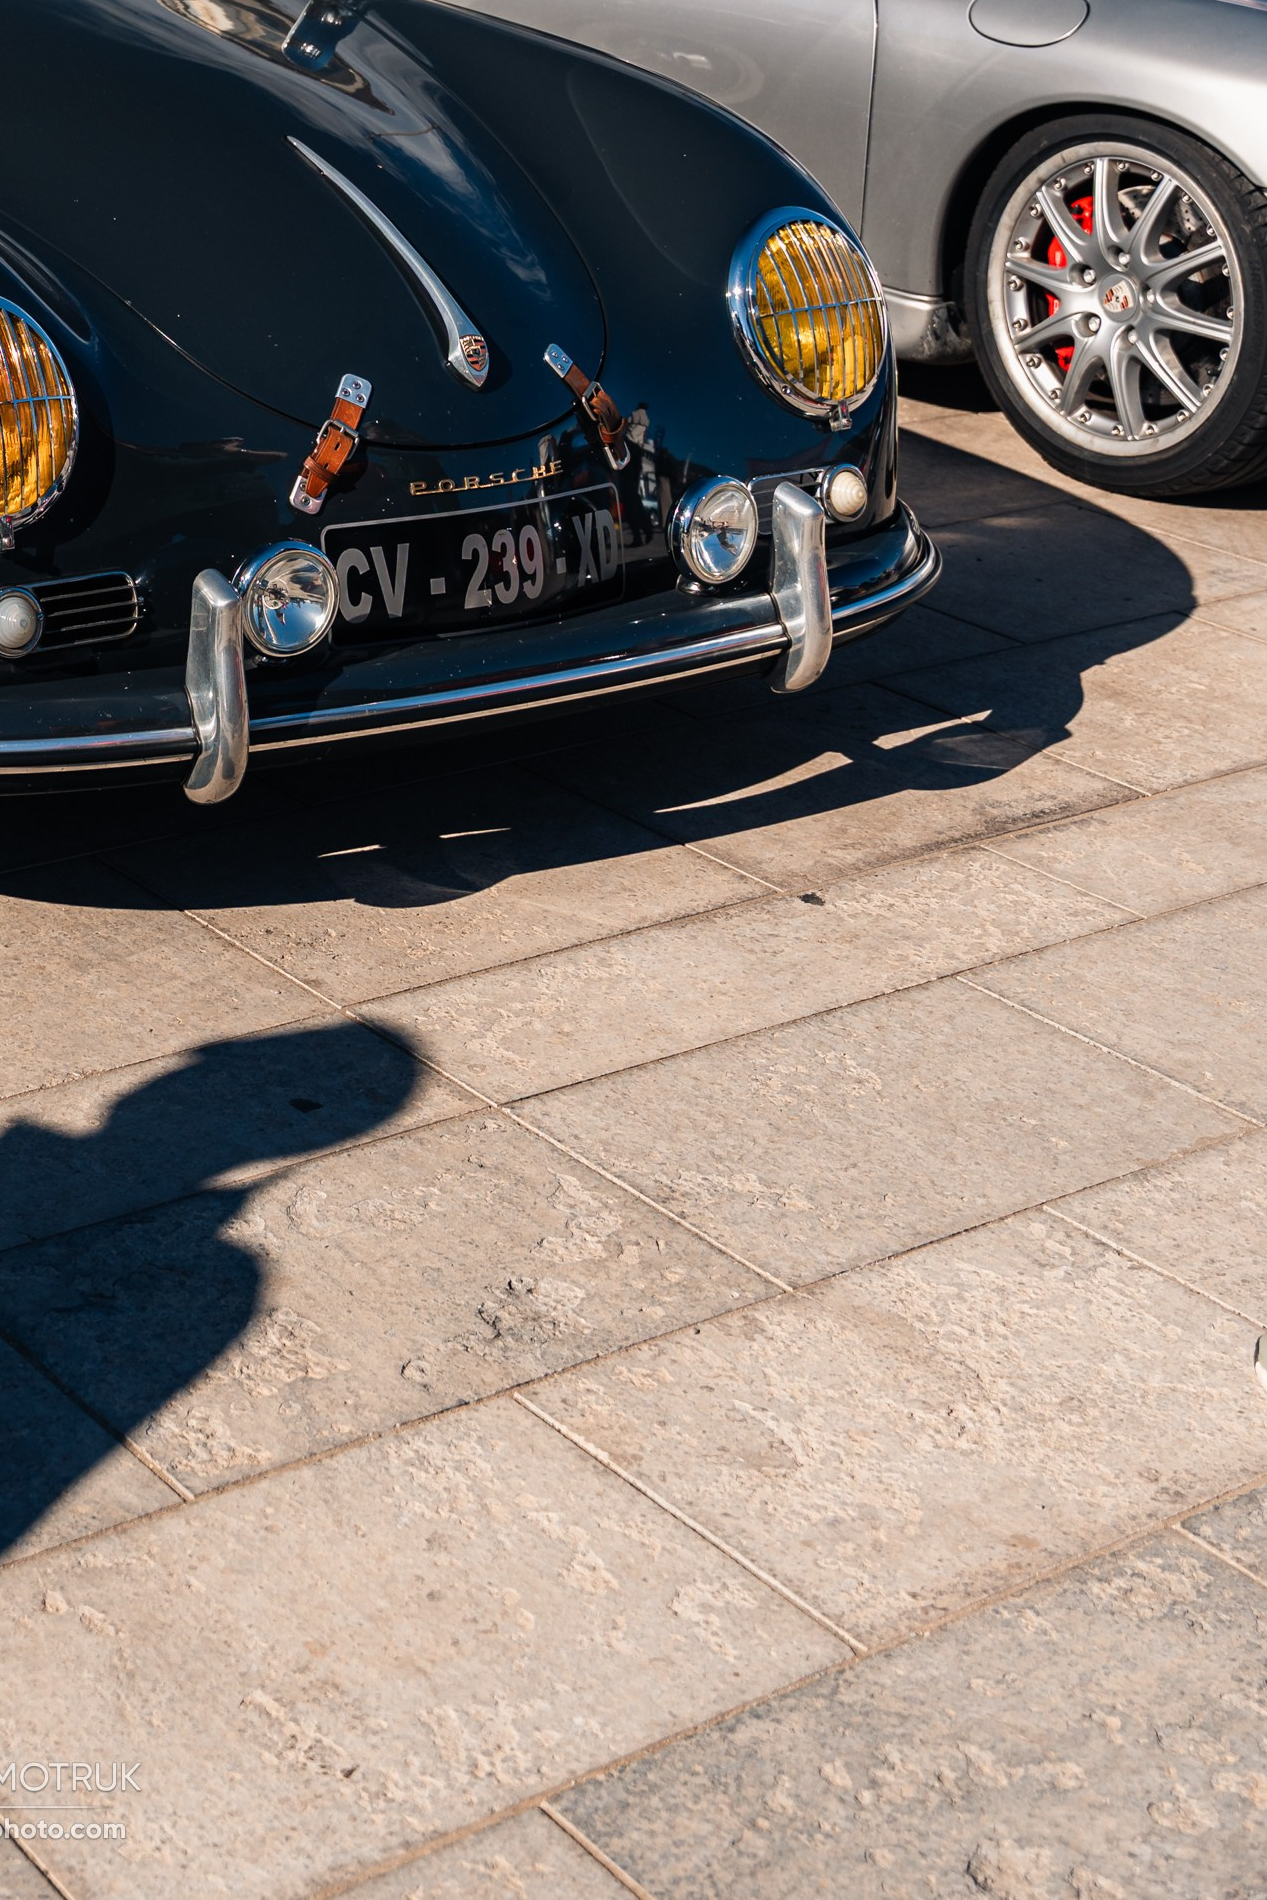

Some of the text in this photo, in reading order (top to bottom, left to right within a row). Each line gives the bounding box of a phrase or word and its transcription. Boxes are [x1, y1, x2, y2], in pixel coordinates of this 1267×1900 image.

[409, 459, 564, 497] PORSCHE
[335, 542, 410, 624] CV
[461, 524, 544, 610] 239
[572, 508, 619, 588] XD
